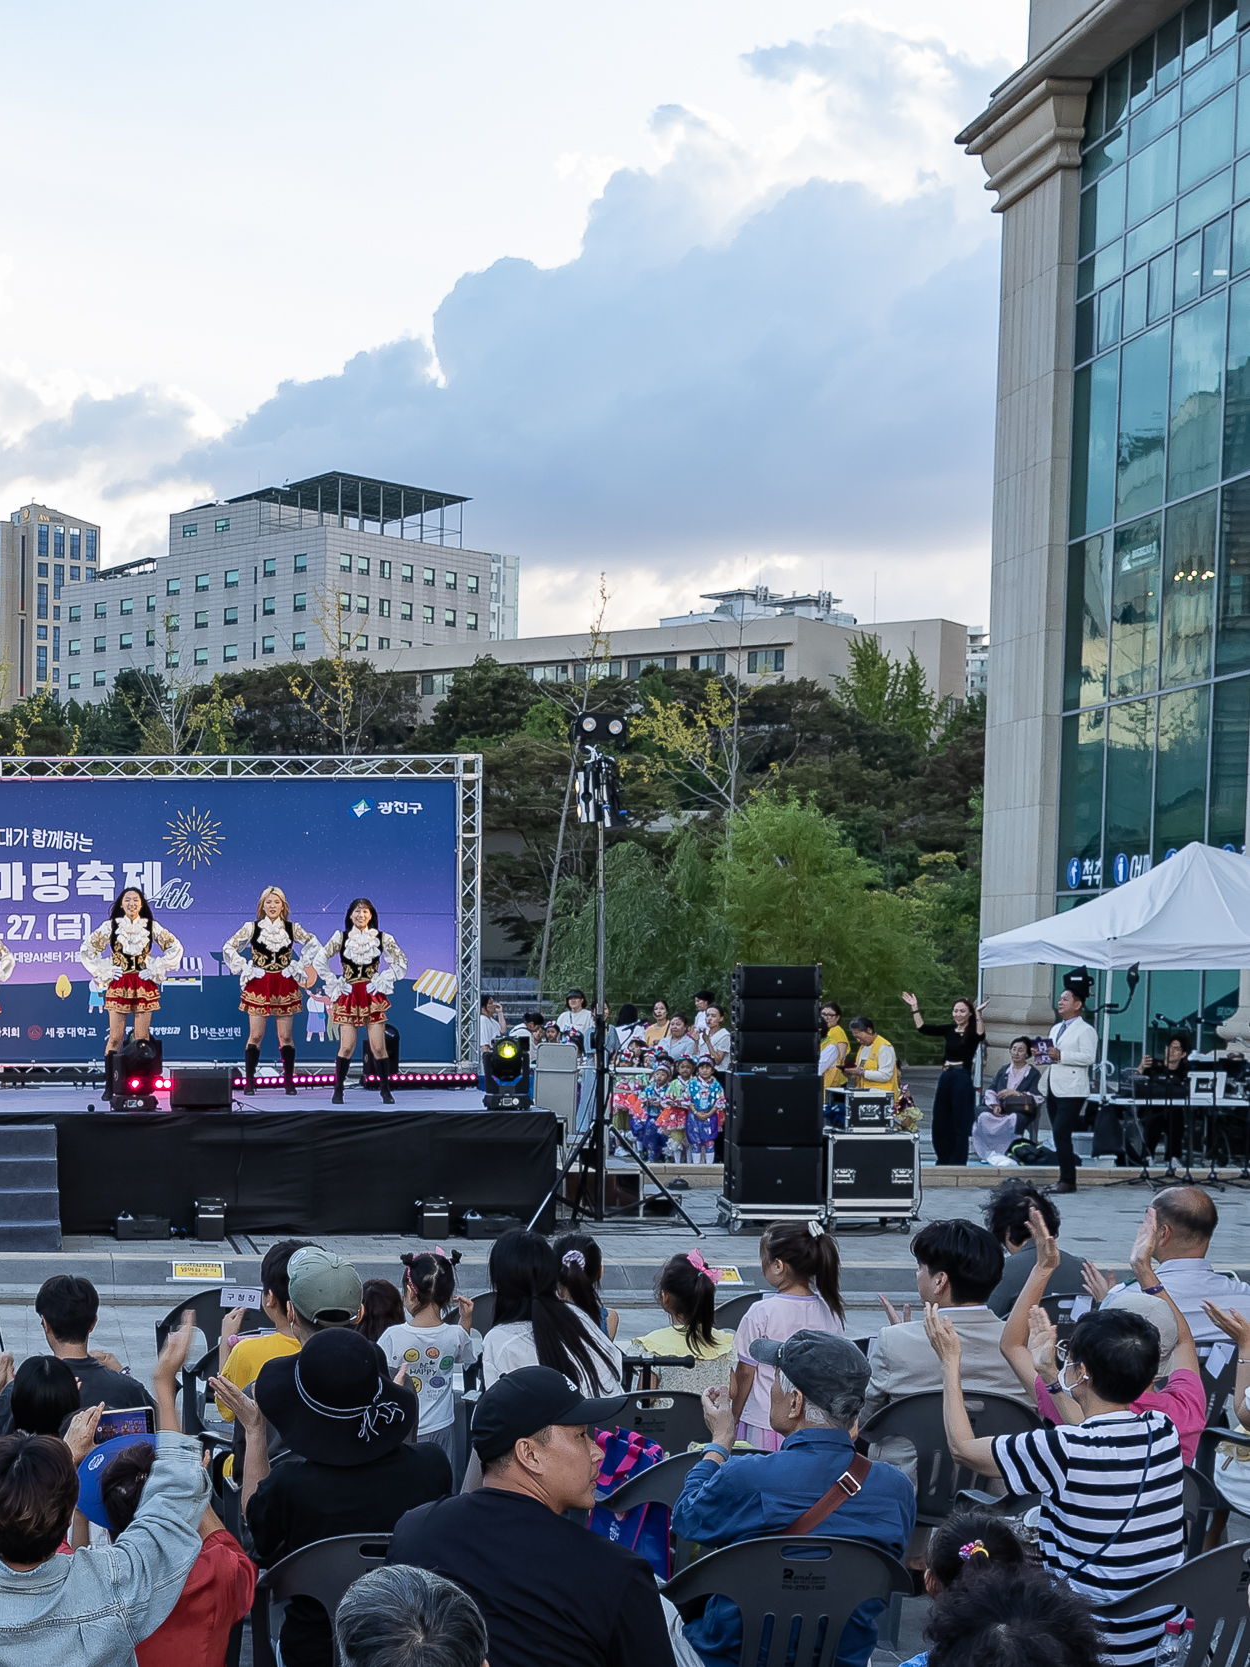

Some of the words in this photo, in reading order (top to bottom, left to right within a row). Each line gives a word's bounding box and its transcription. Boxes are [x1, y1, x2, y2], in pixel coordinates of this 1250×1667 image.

[377, 801, 424, 815] 광진구
[31, 828, 93, 853] 함께하는
[147, 877, 194, 909] 4th
[45, 1026, 97, 1038] 세종대학교
[200, 1026, 242, 1037] 바른본병원
[410, 1368, 437, 1376] HAPPY
